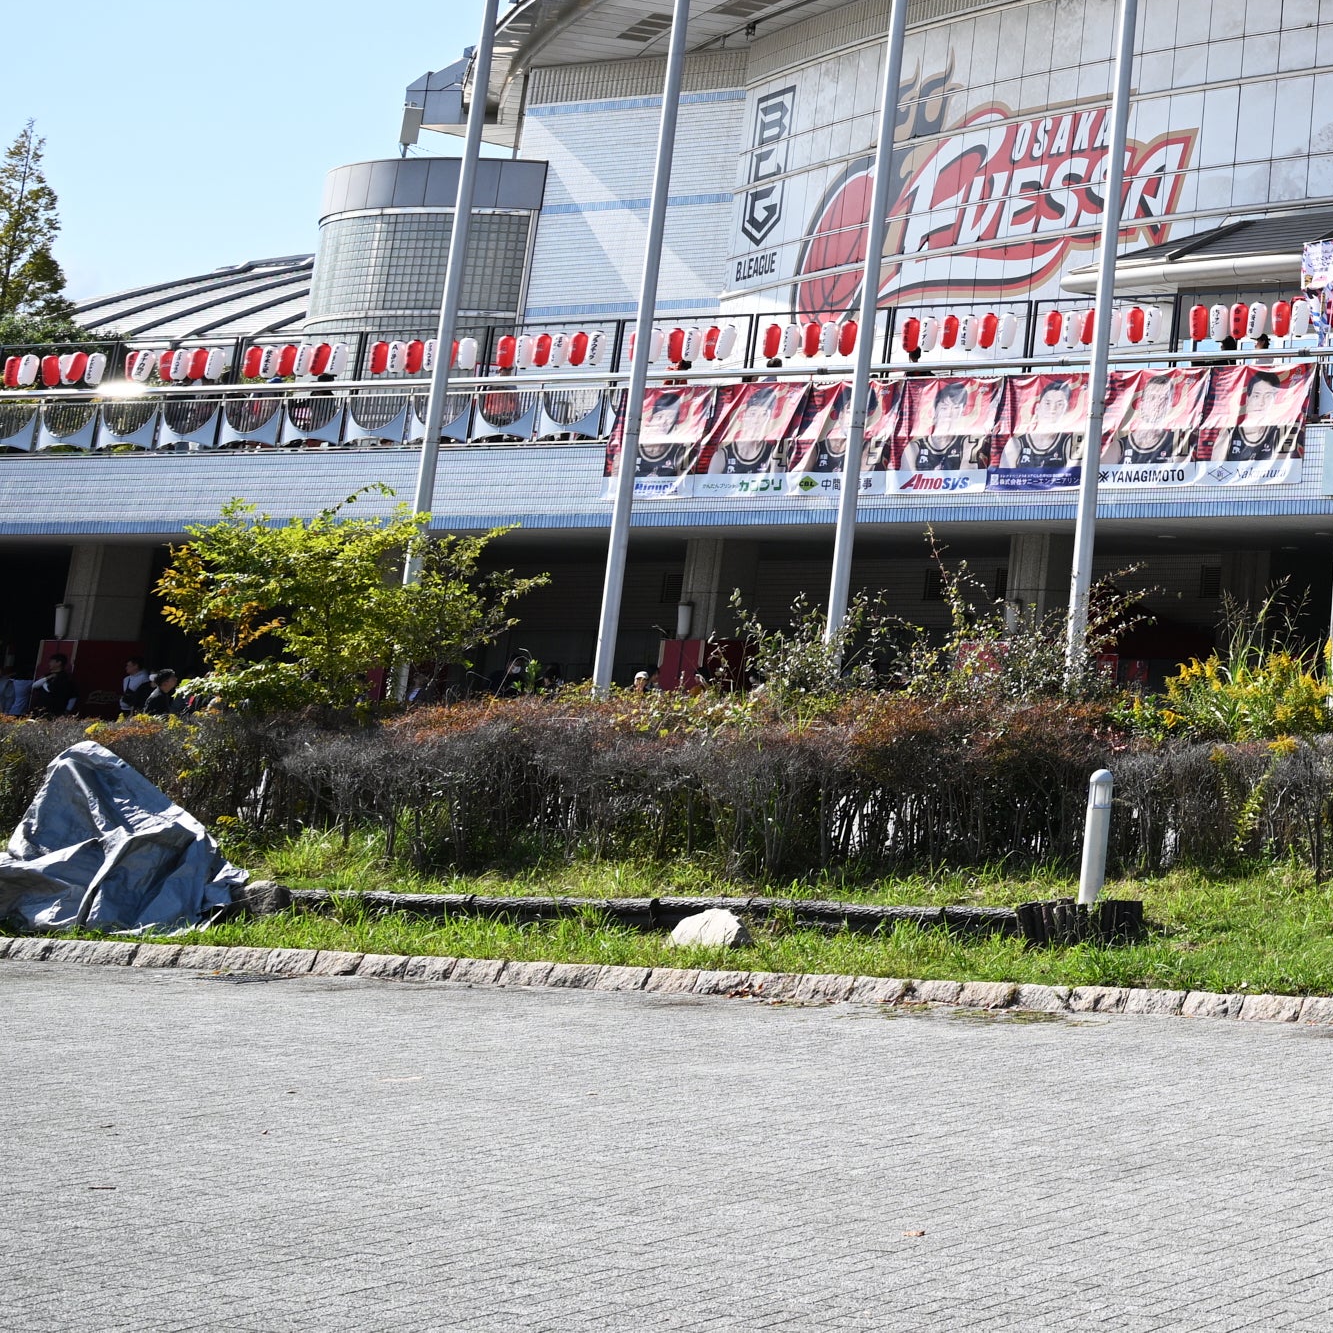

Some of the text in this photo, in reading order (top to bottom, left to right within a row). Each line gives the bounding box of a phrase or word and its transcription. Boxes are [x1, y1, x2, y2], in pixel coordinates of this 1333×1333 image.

[1012, 108, 1114, 161] OSAKA
[735, 252, 777, 282] B.LEAGUE
[821, 477, 873, 491] 中間事
[900, 473, 970, 490] Amosys
[1111, 469, 1185, 483] YANAGIMOTO
